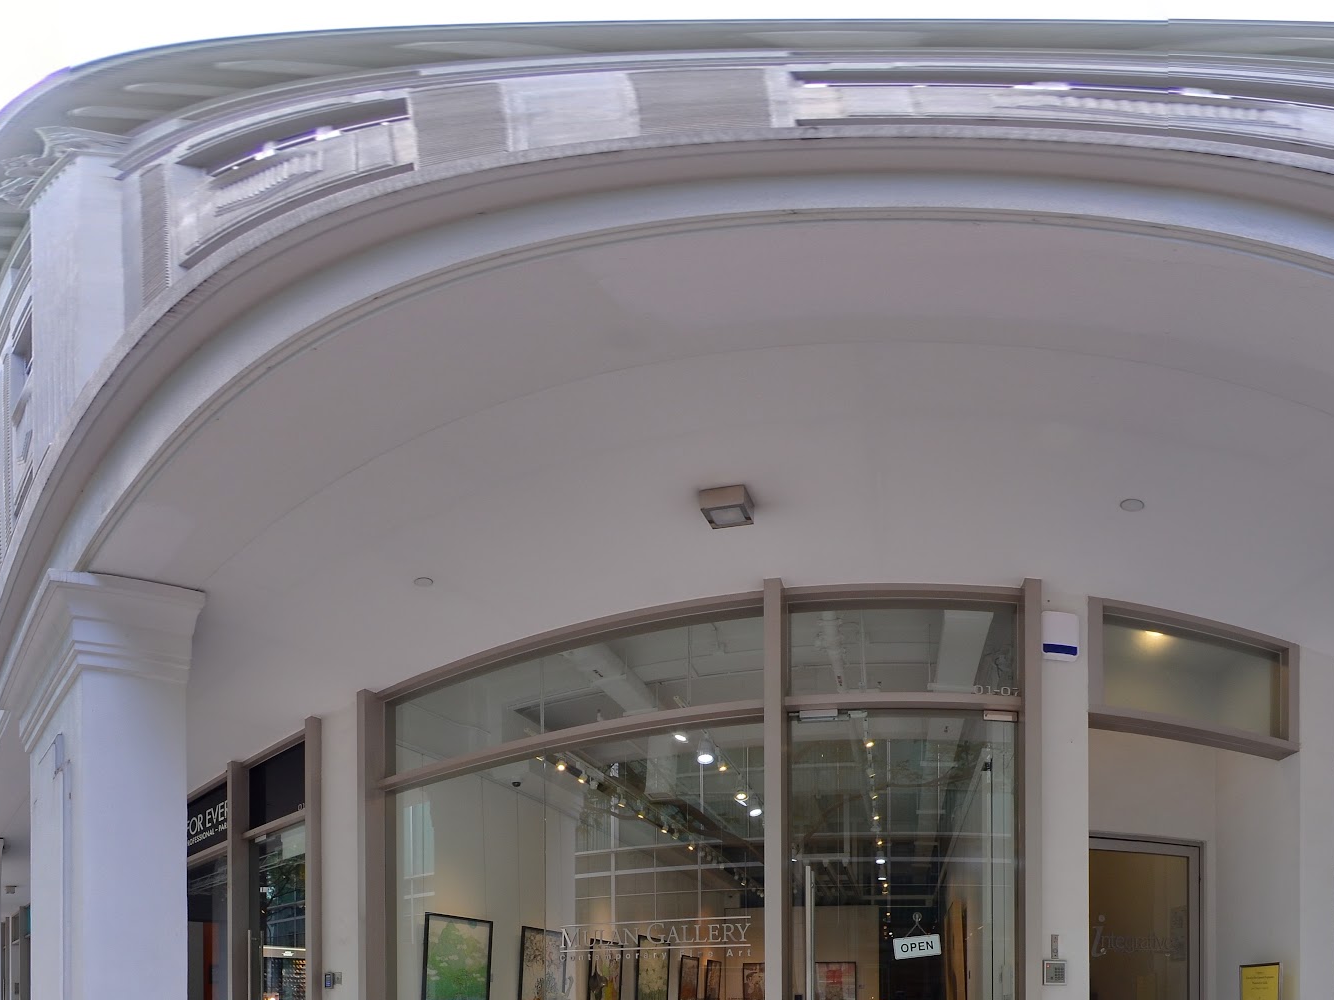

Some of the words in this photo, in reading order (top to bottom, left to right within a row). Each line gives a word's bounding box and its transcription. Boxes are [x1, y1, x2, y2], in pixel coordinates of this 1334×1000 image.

[973, 685, 1019, 697] 01-07
[560, 926, 640, 948] MULAN
[647, 922, 752, 944] GALLERY
[726, 948, 752, 957] Art
[900, 940, 934, 953] OPEN
